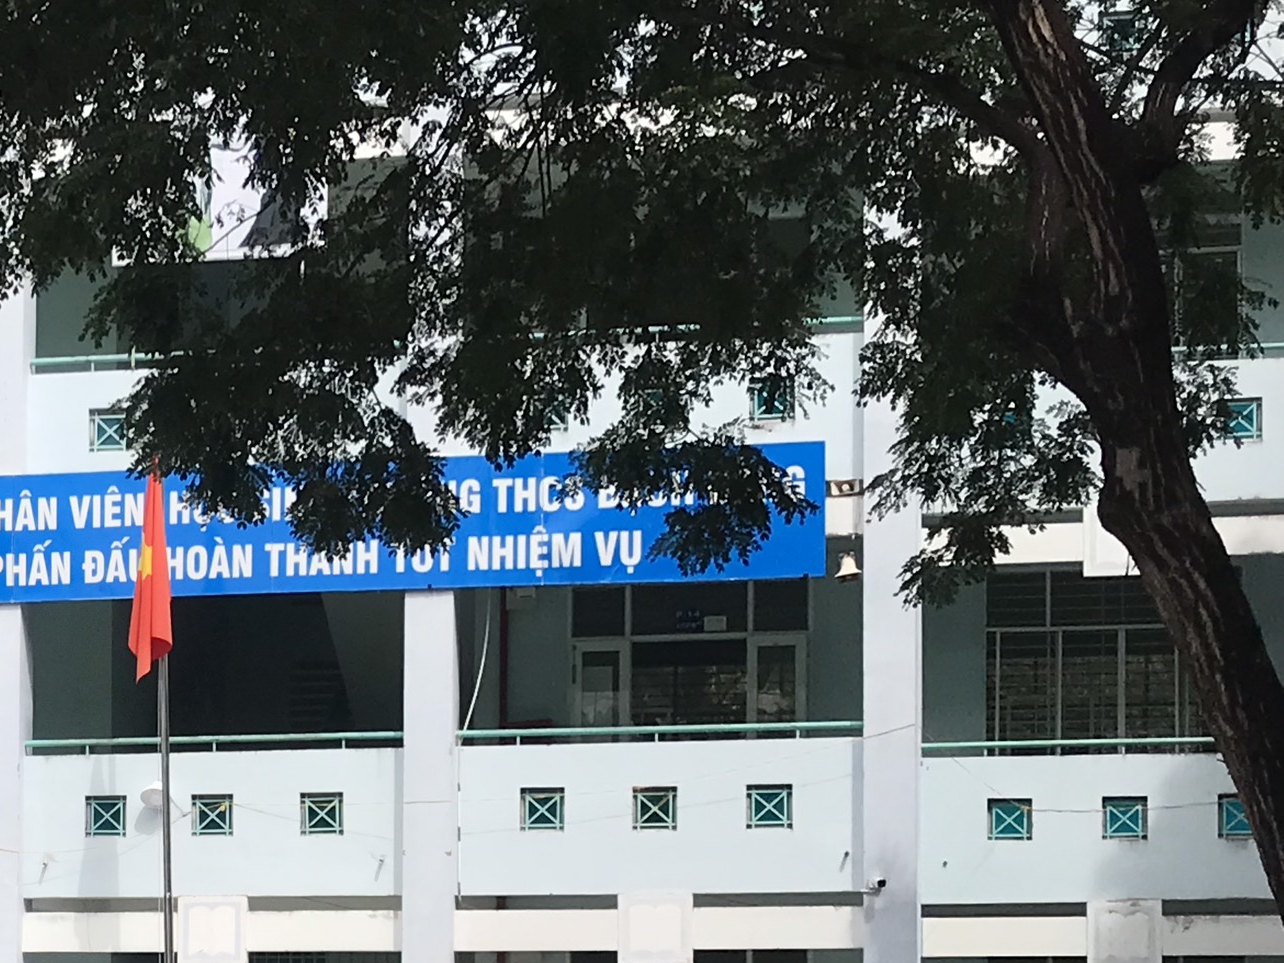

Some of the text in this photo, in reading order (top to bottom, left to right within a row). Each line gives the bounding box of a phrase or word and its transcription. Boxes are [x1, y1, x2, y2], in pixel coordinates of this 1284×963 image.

[166, 537, 253, 583] HOÀN
[467, 525, 582, 577] NHIỆM
[594, 530, 642, 574] VỤ
